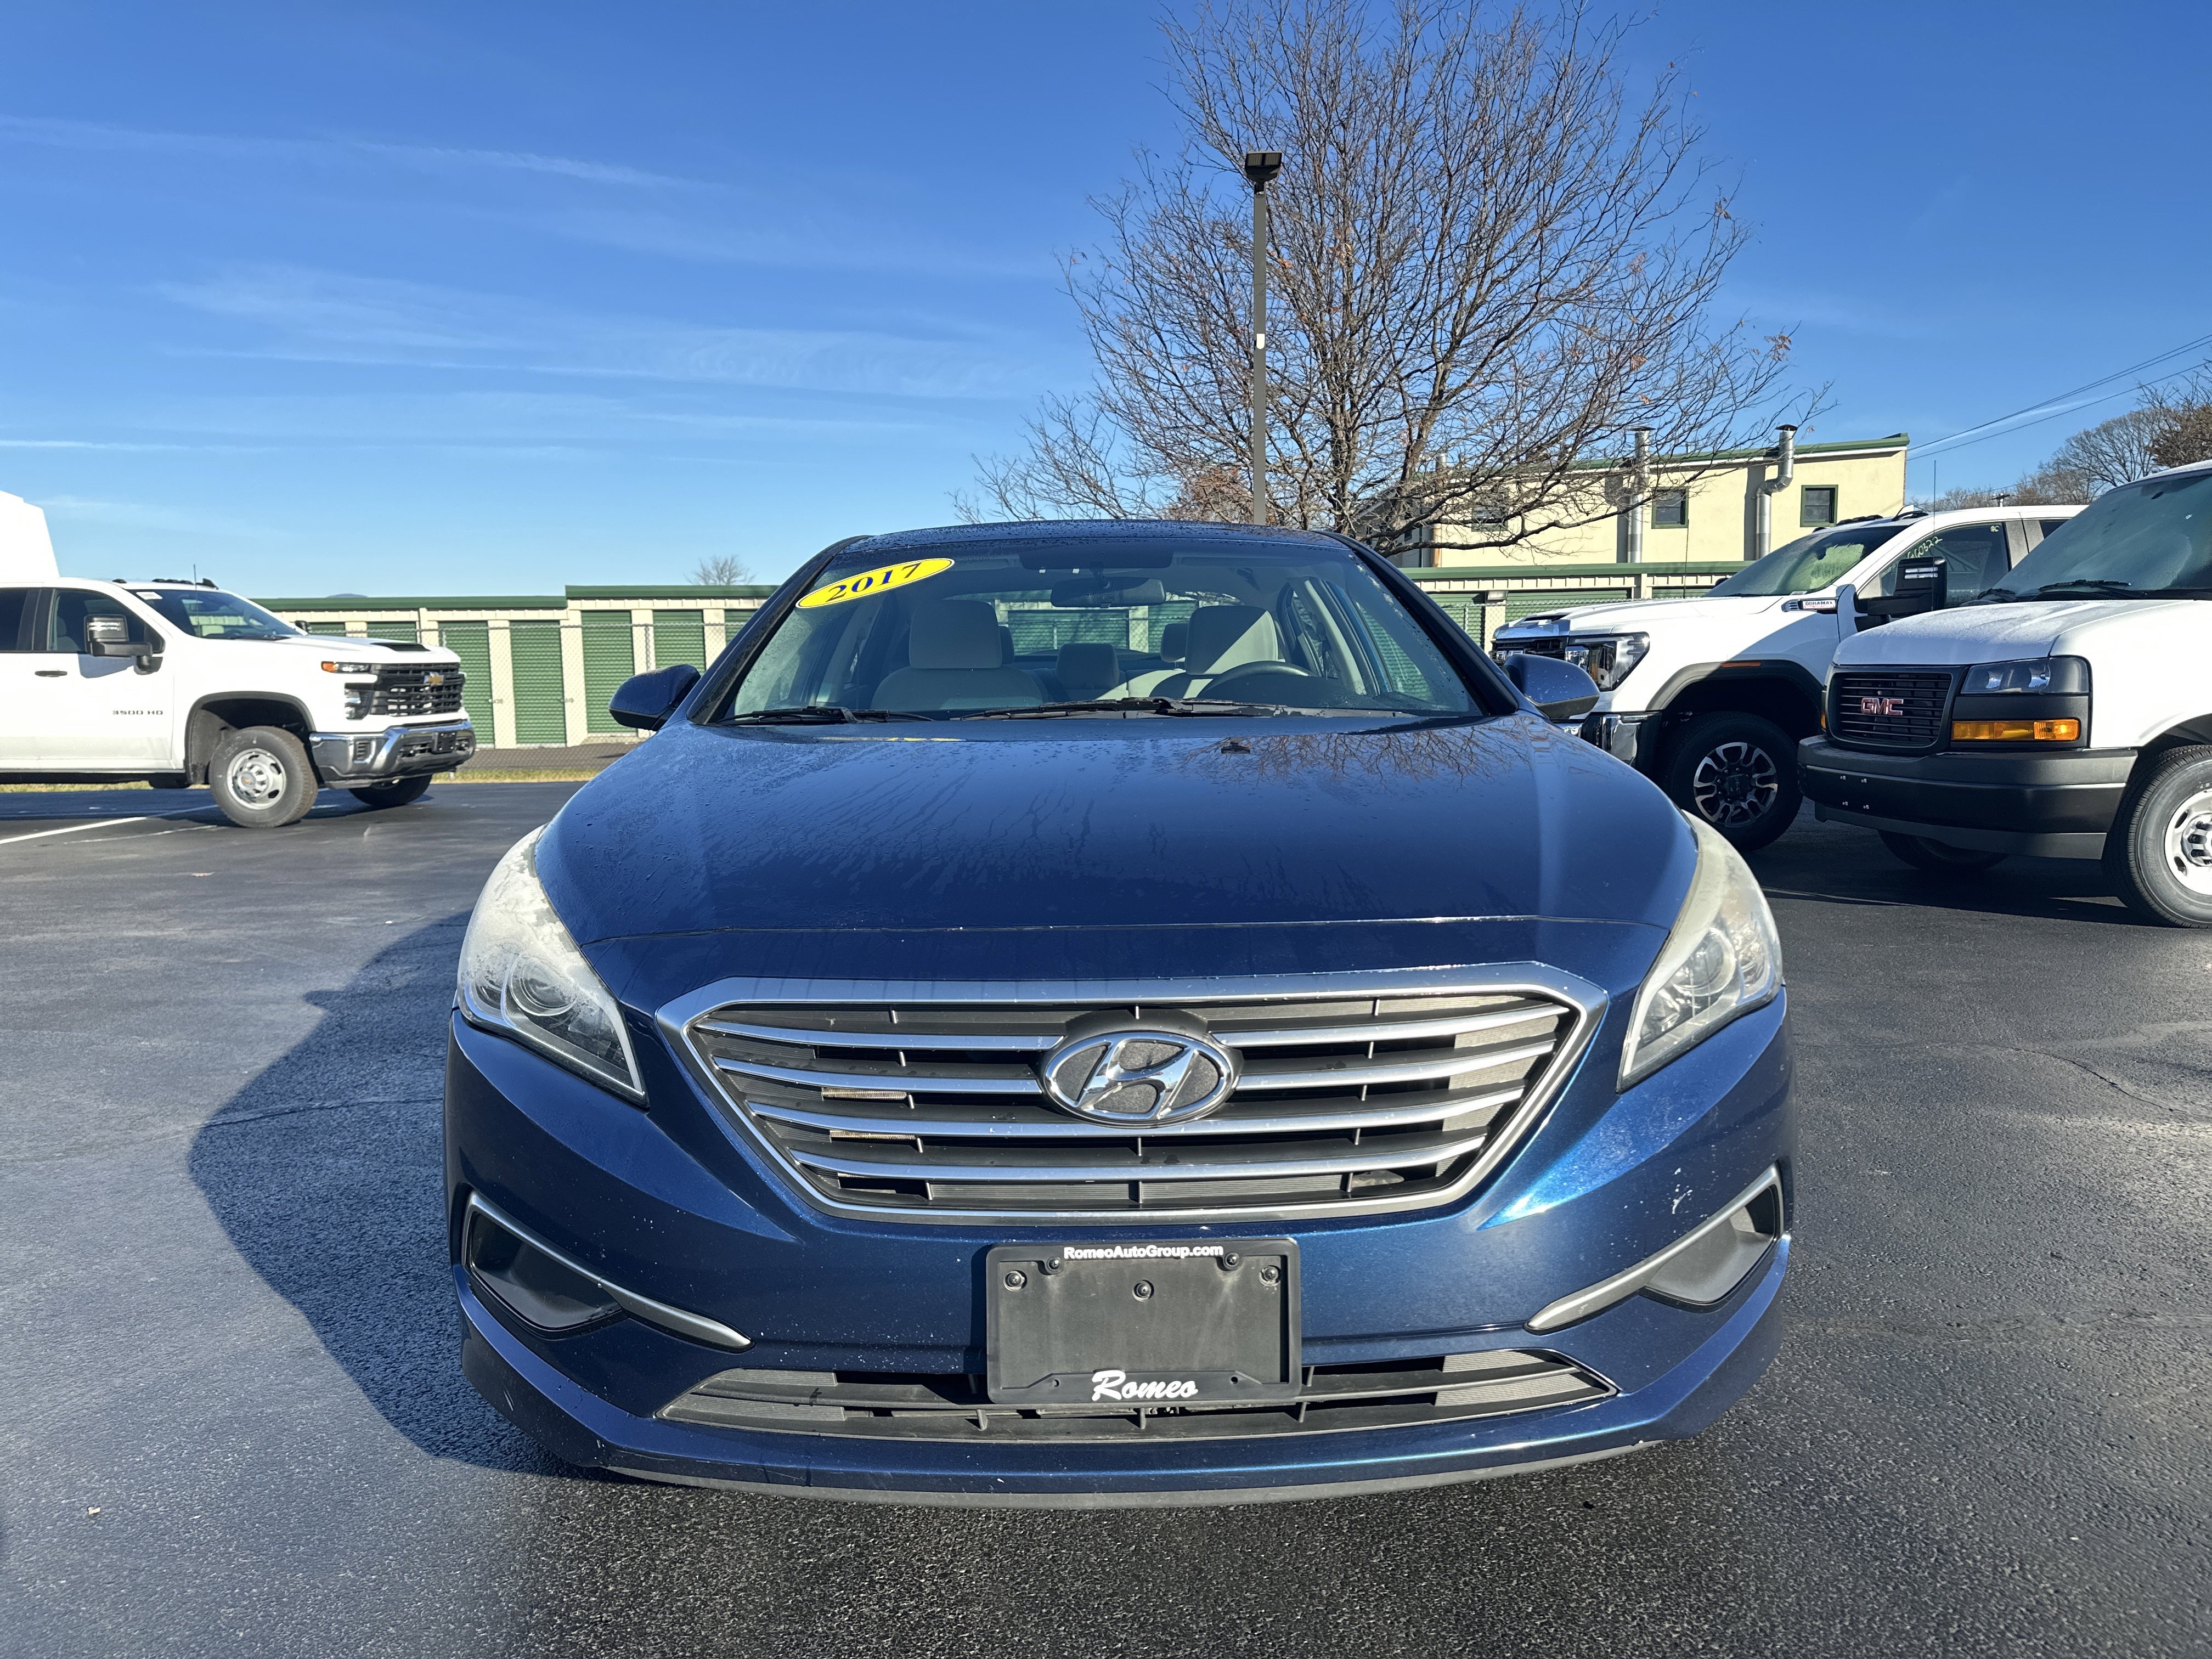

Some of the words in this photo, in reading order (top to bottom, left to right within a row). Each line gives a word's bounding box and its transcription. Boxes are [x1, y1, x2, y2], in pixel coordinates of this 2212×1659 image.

[825, 562, 922, 602] 2017
[1861, 697, 1903, 715] GMC
[1064, 1245, 1223, 1259] RomeoAutoGroup.com
[1092, 1370, 1198, 1401] Romeo
